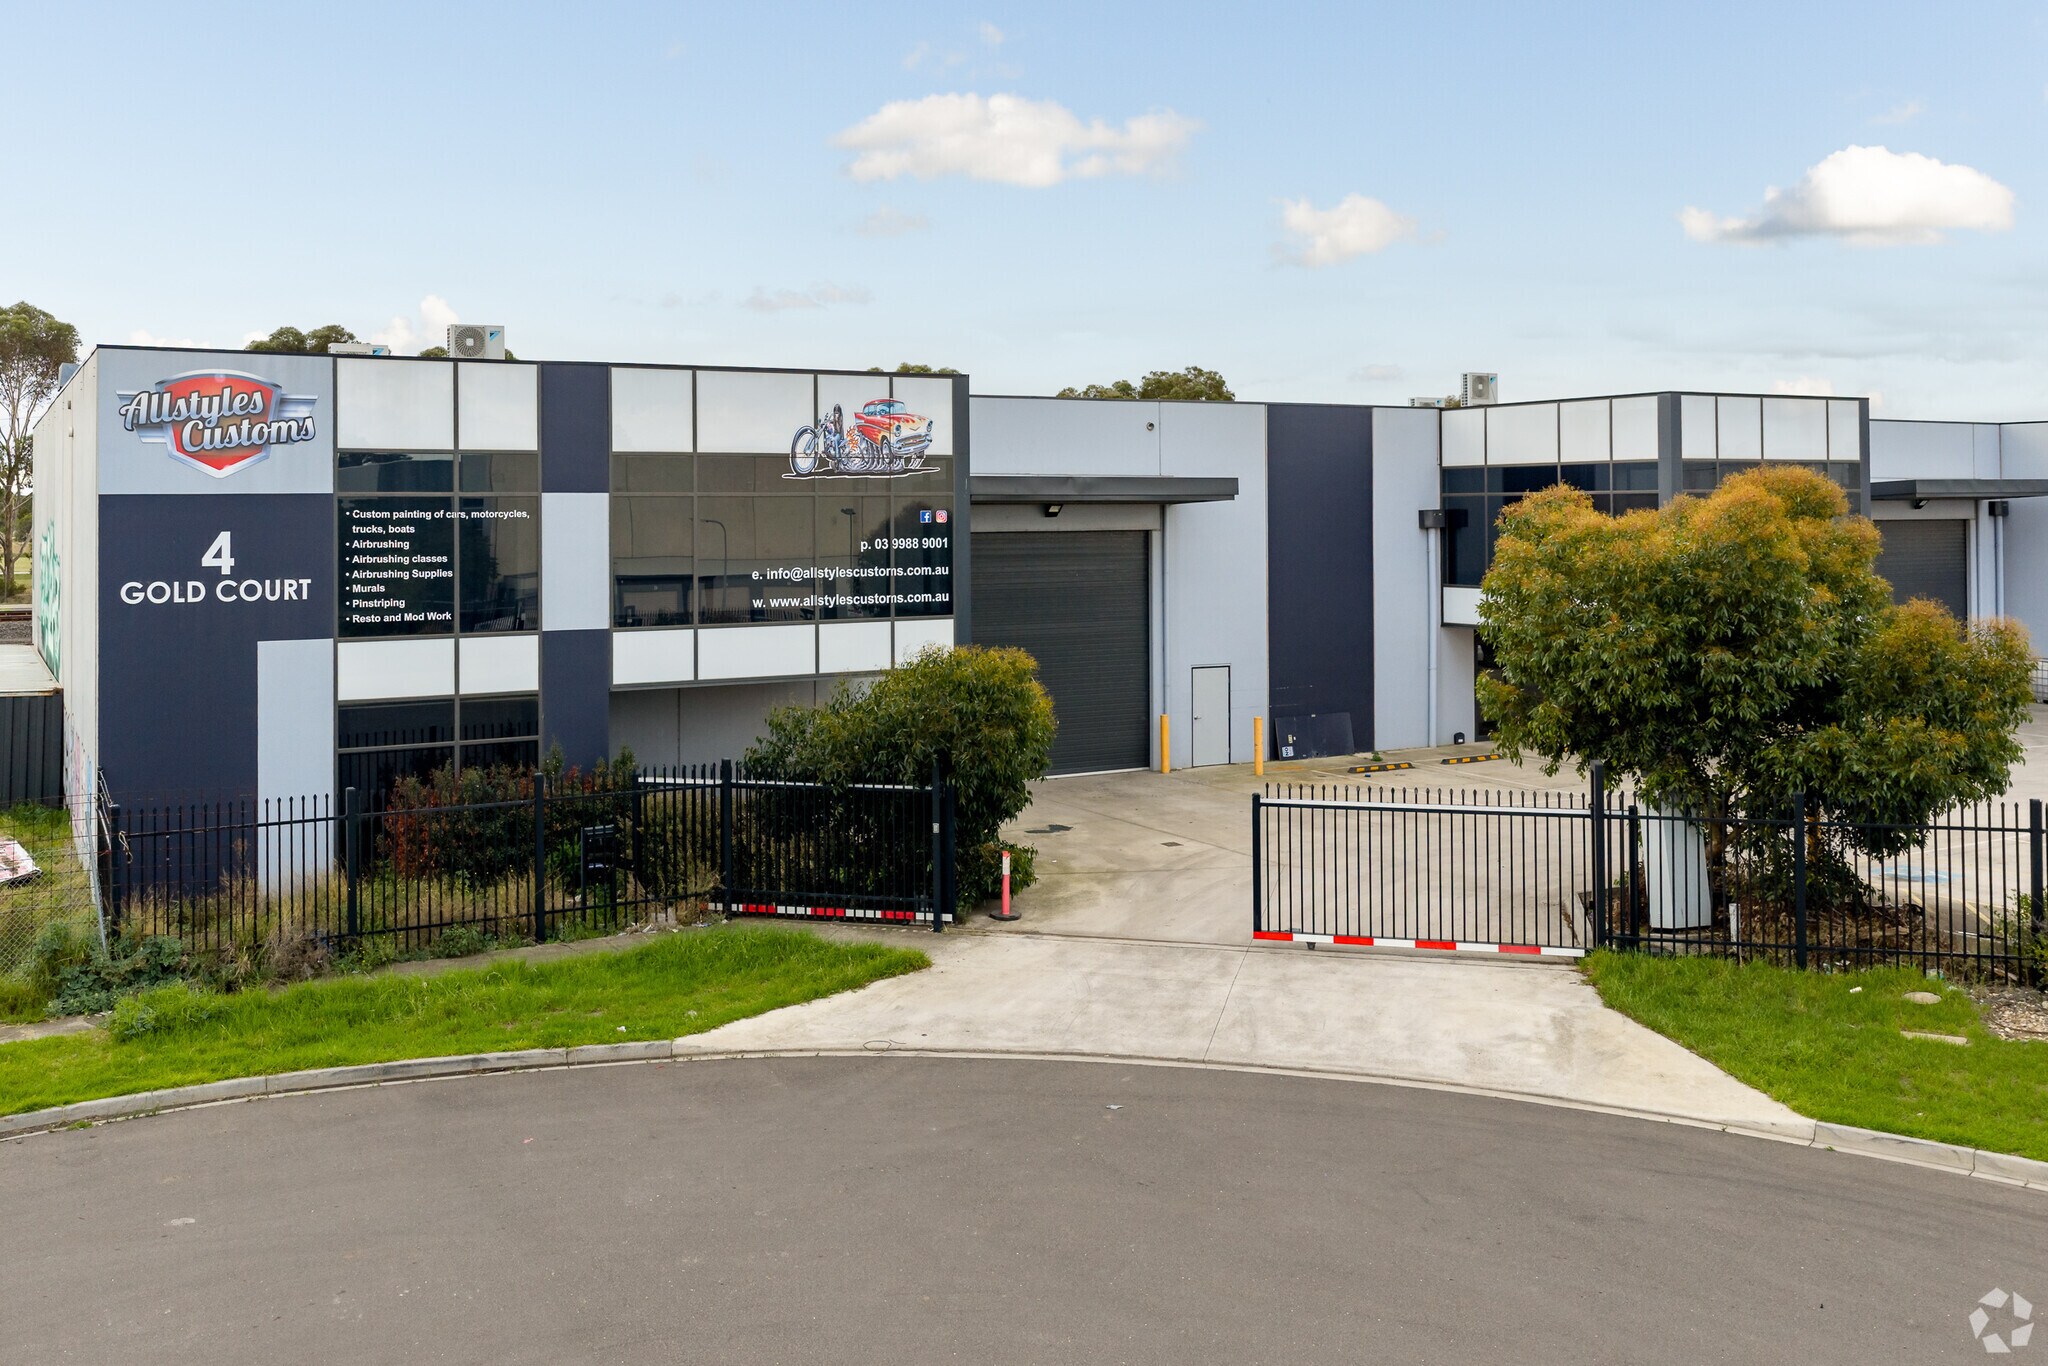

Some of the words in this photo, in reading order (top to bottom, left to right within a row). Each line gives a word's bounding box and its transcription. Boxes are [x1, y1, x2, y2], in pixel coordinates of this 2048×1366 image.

[119, 386, 264, 431] Allstyles
[181, 416, 316, 452] Customs
[352, 510, 390, 519] Custom
[393, 510, 431, 520] painting
[434, 510, 444, 518] of
[446, 511, 469, 520] cars,
[471, 509, 530, 519] motorcycles,
[352, 525, 386, 535] trucks,
[388, 525, 415, 534] boats
[352, 540, 410, 550] Airbrushing
[860, 540, 872, 552] p.
[874, 538, 889, 549] 03
[892, 538, 919, 549] 9988
[922, 537, 948, 549] 9001
[201, 531, 235, 575] 4
[352, 555, 410, 565] Airbrushing
[412, 555, 448, 563] classes
[352, 569, 410, 580] Airbrushing
[412, 569, 453, 579] Supplies
[751, 571, 763, 580] e.
[766, 566, 949, 582] info@allstylescustoms.com.au
[120, 581, 206, 604] GOLD
[216, 579, 312, 602] COURT
[352, 584, 385, 593] Murals
[352, 599, 406, 609] Pinstriping
[752, 598, 766, 608] w.
[769, 592, 950, 609] www.allstylescustoms.com.au
[352, 614, 381, 623] Resto
[383, 613, 401, 622] and
[404, 612, 425, 621] Mod
[427, 611, 452, 620] Work
